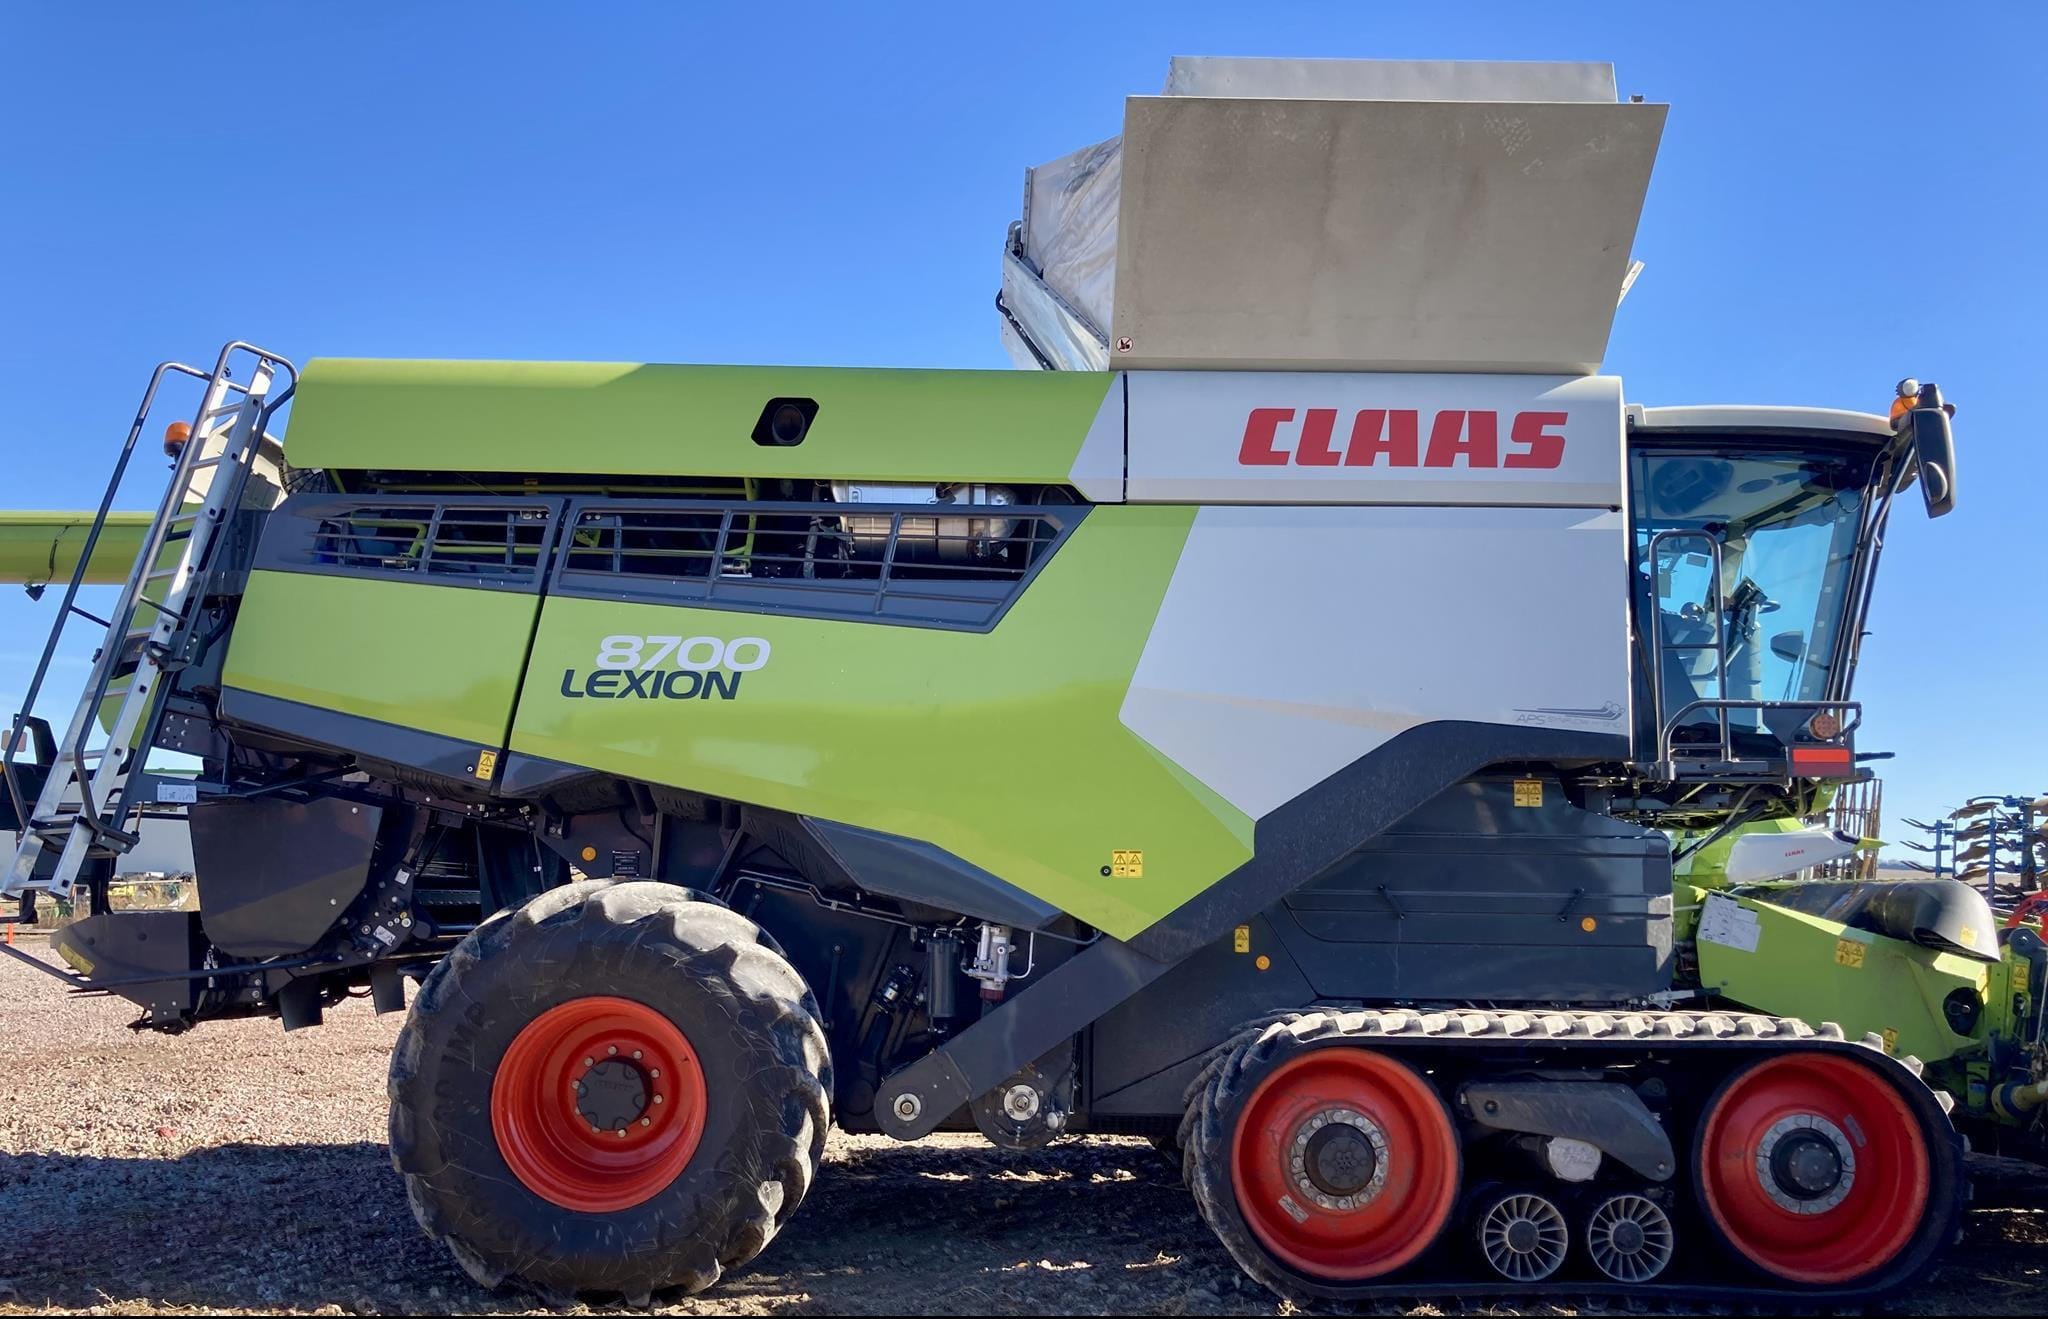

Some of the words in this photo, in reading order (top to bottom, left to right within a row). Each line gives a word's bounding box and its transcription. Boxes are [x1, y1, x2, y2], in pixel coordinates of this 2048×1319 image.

[1238, 408, 1568, 469] CLAAS
[596, 635, 771, 671] 8700
[561, 669, 742, 700] LEXION
[1516, 713, 1545, 725] APS
